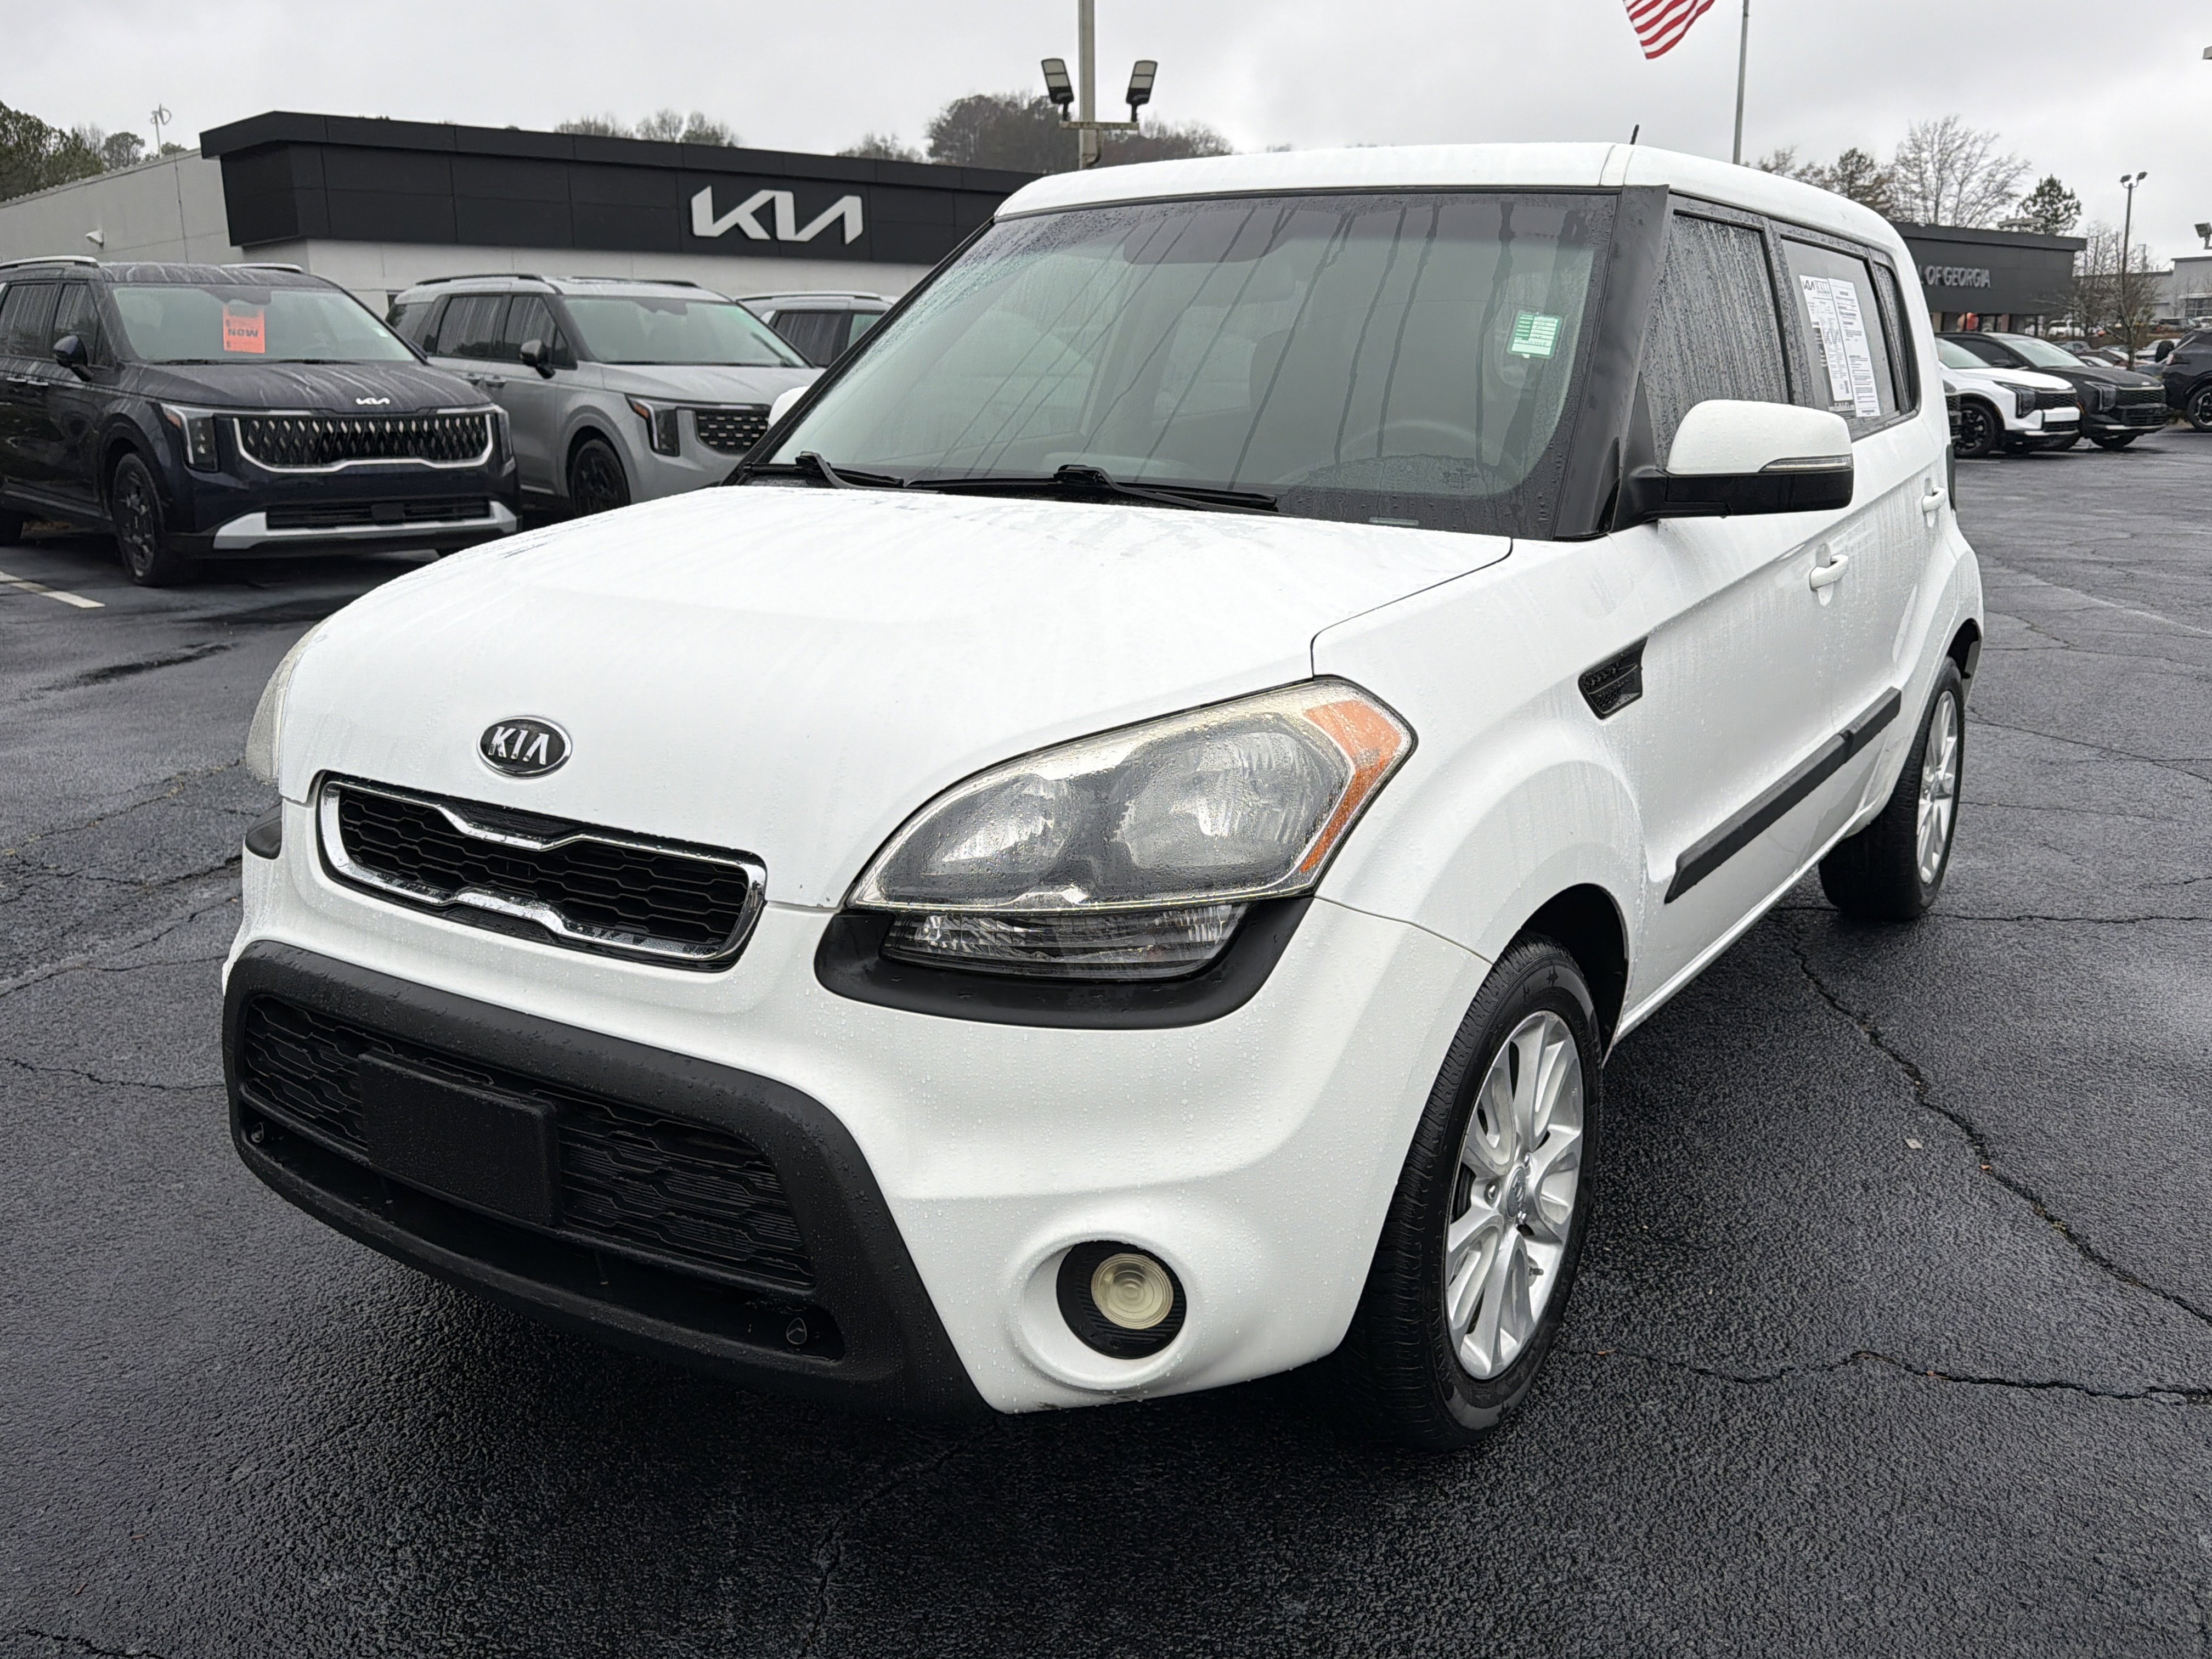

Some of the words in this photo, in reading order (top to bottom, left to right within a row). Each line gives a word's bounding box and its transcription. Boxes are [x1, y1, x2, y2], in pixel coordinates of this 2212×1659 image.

[691, 185, 863, 245] KIA
[1925, 266, 1943, 285] OF
[1943, 267, 1990, 287] GEORGIA
[228, 329, 258, 337] NOW
[488, 726, 550, 765] KIA
